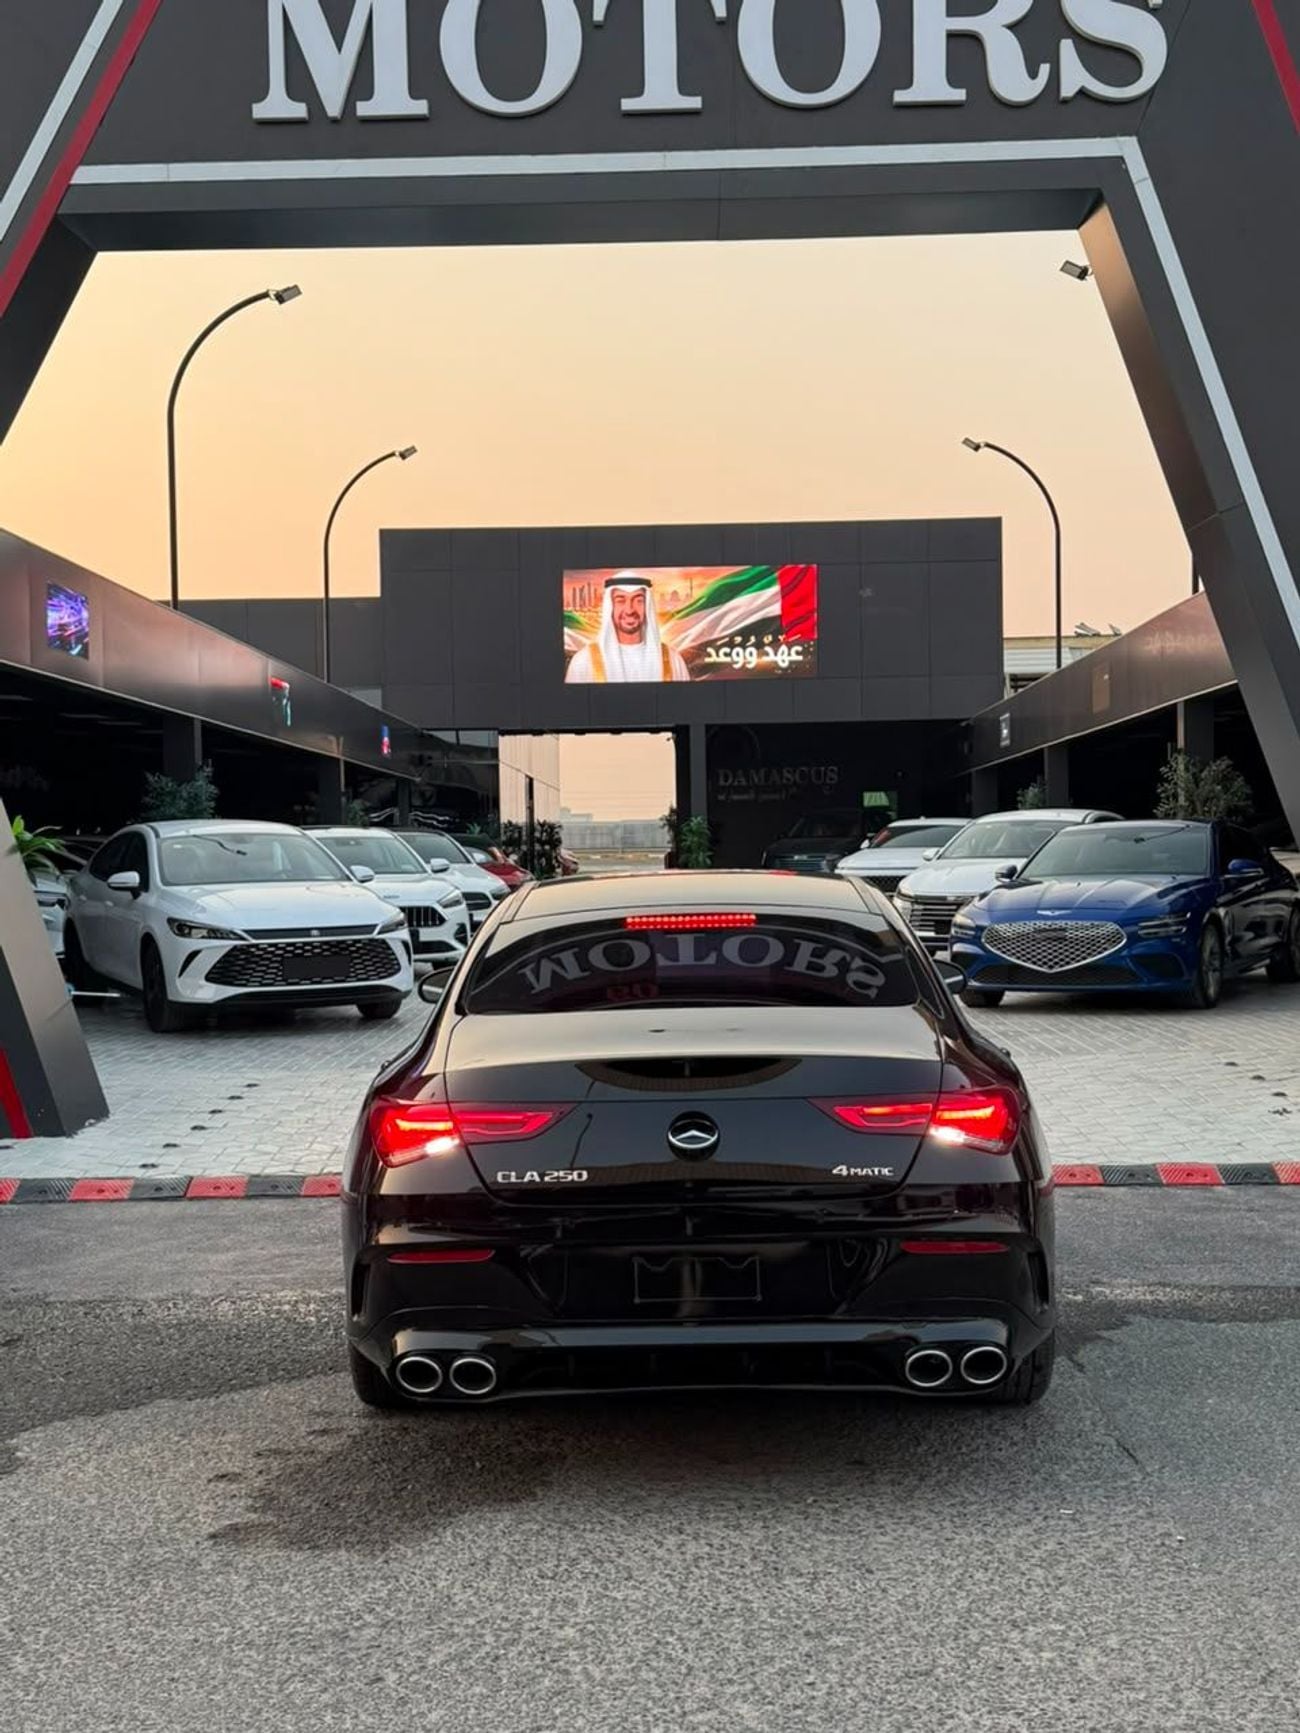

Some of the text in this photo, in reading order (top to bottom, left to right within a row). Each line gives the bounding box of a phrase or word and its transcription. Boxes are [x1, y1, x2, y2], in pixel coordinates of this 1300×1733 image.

[251, 0, 1169, 122] MOTORS
[717, 765, 839, 787] DAMASCUS
[497, 1170, 588, 1183] CLA 250
